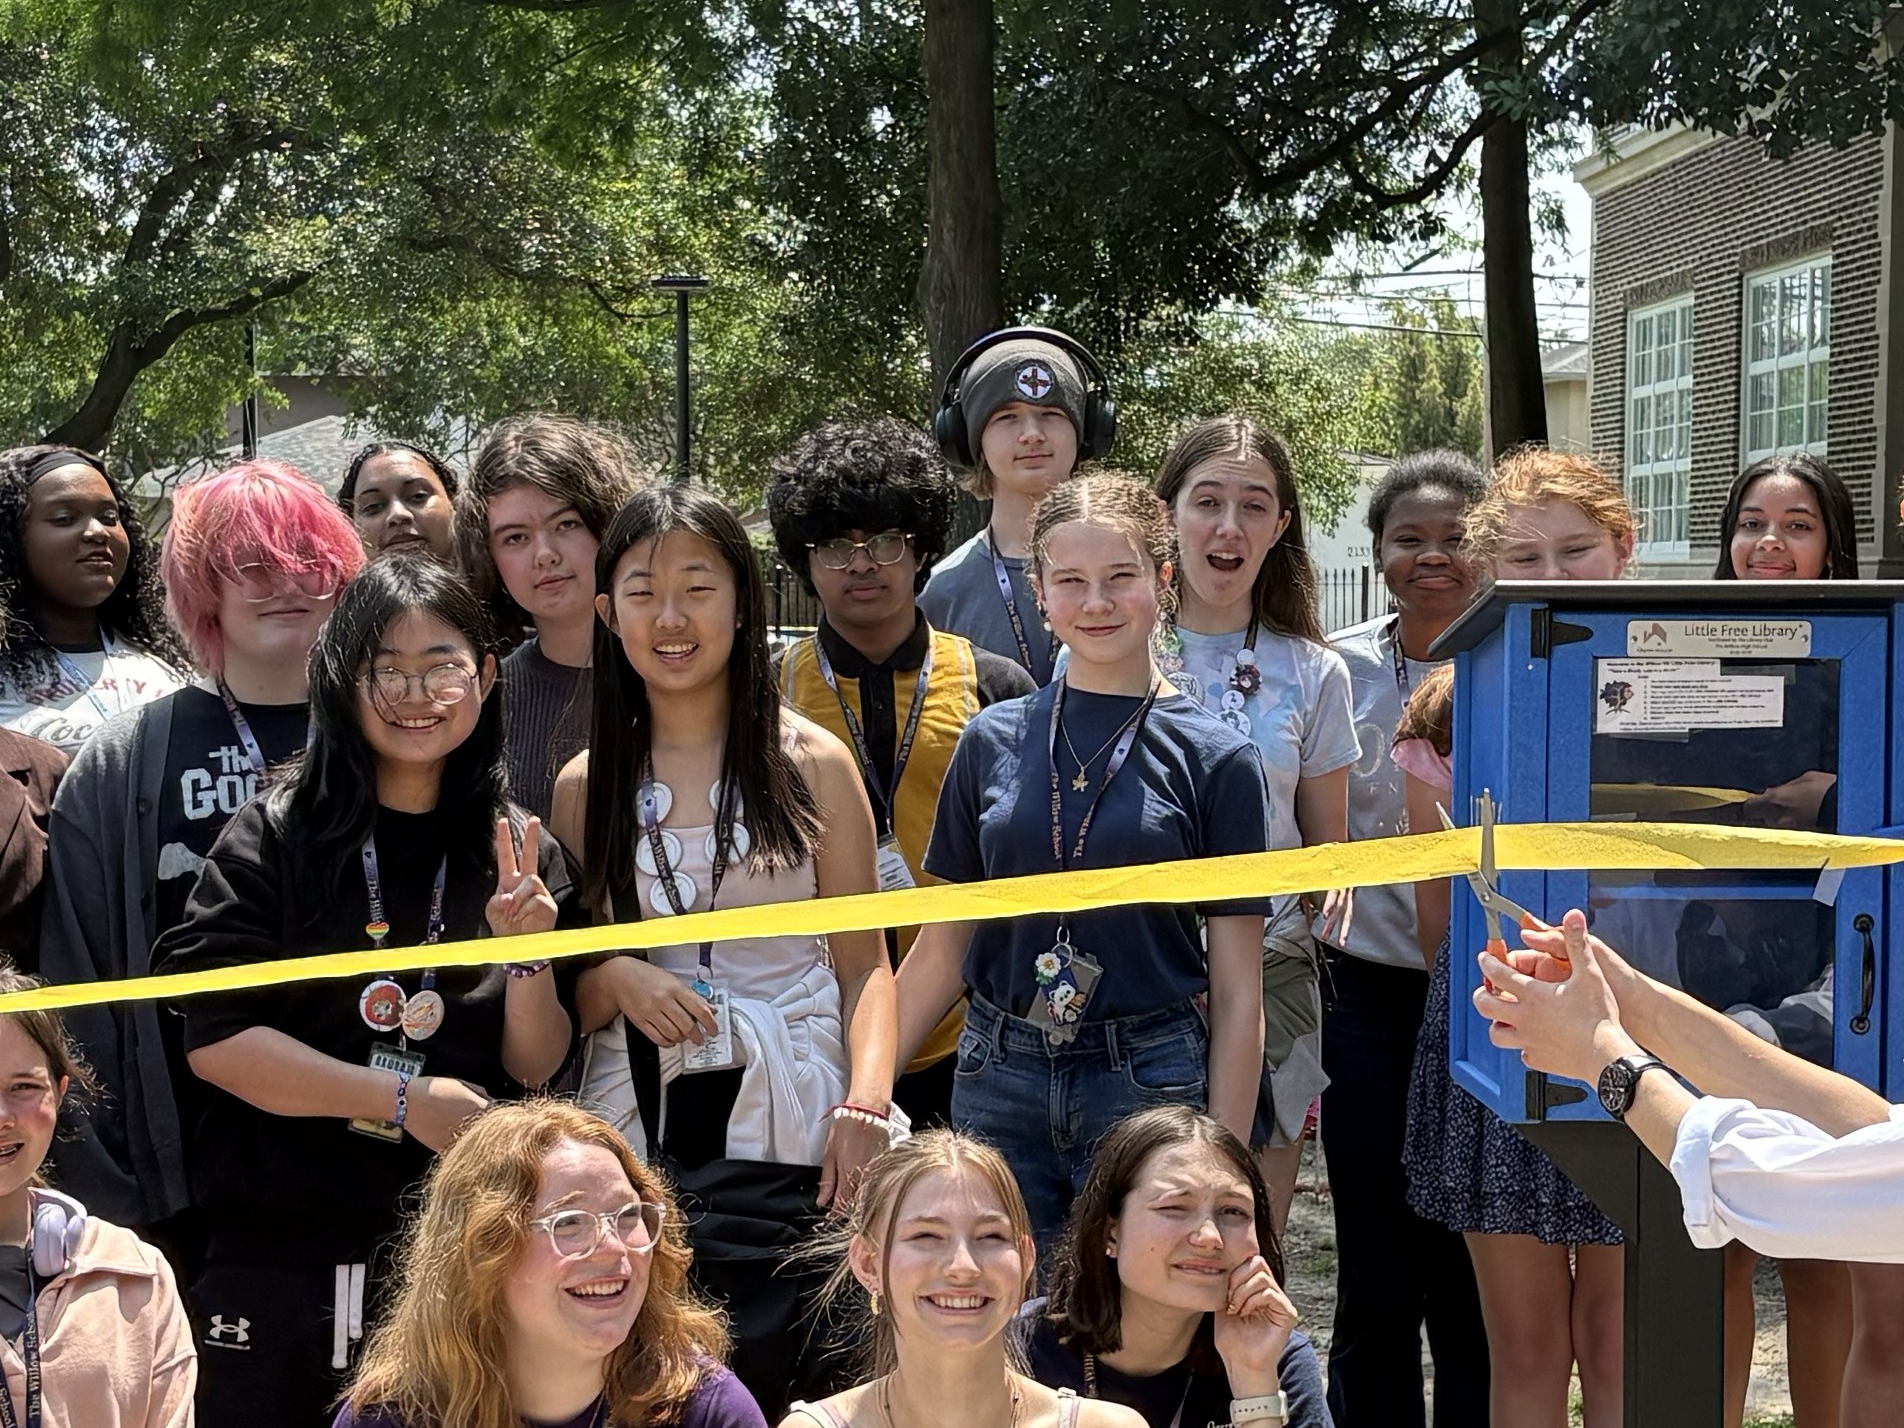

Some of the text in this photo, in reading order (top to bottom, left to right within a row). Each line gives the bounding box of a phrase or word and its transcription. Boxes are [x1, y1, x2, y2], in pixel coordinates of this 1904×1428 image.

[1684, 623, 1798, 640] Little Free Library
[27, 1351, 39, 1391] Willow
[28, 1394, 40, 1418] The
